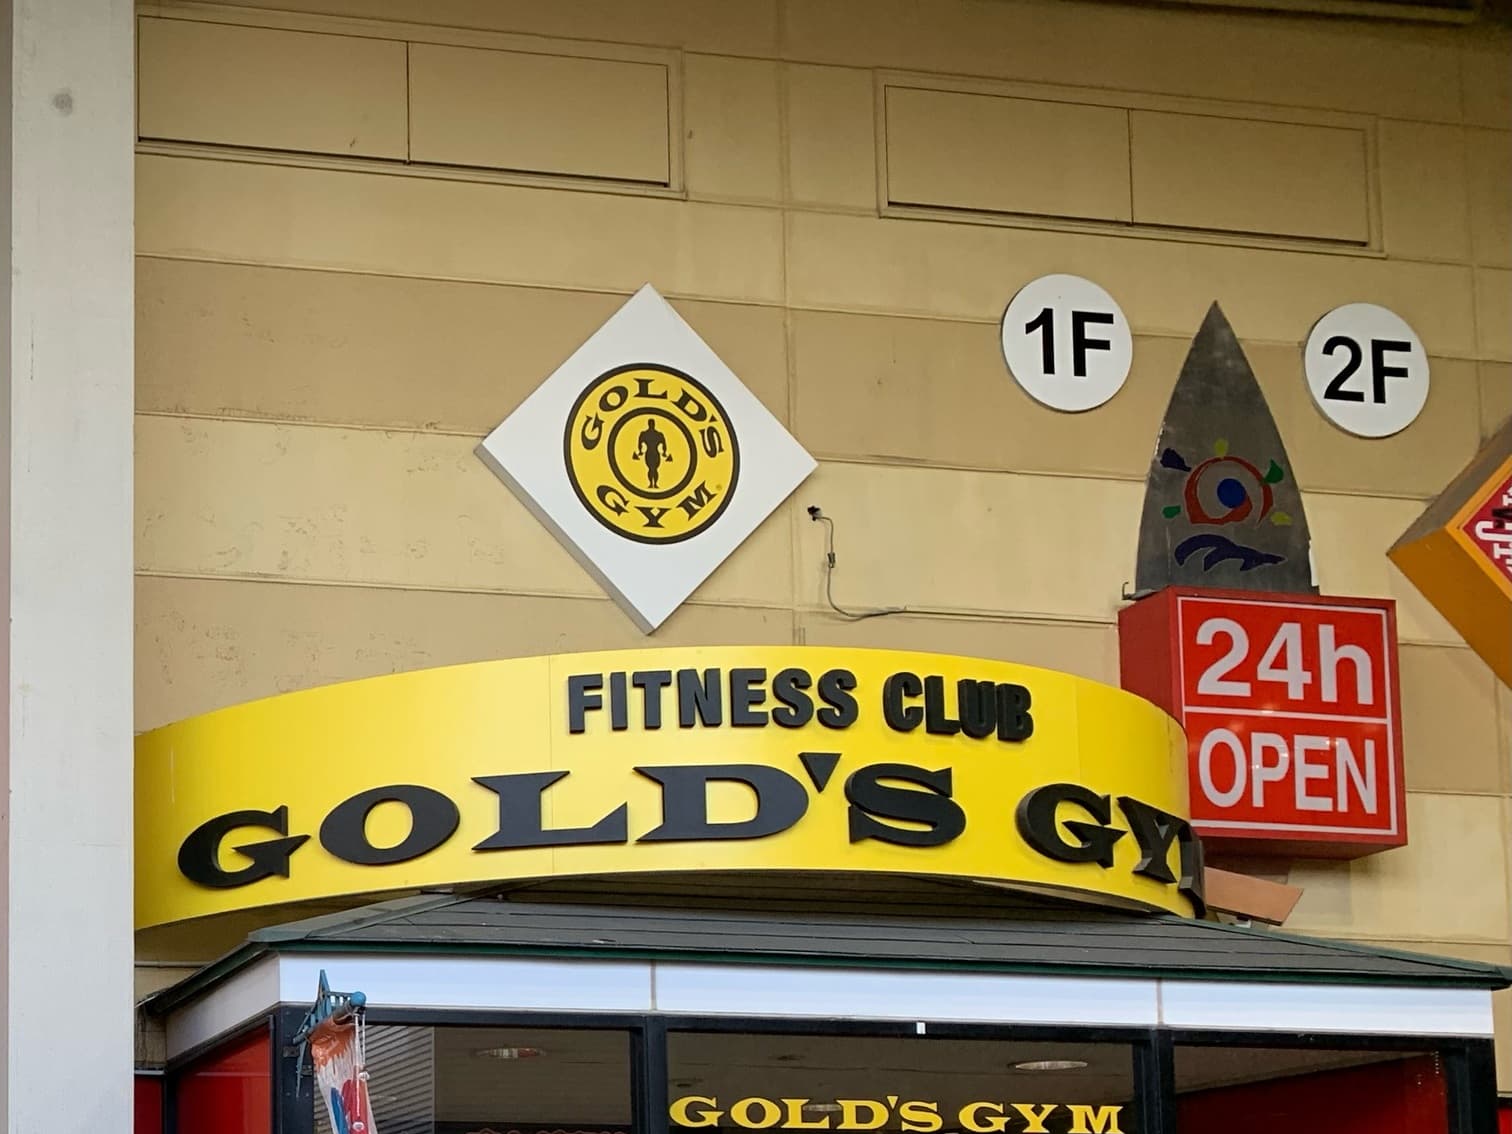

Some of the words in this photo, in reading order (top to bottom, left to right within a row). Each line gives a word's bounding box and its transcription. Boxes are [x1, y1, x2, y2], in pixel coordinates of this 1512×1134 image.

[1025, 307, 1115, 378] 1F
[1322, 336, 1412, 404] 2F
[580, 377, 724, 459] GOLD'S
[596, 479, 717, 528] GYM
[1195, 618, 1374, 706] 24h
[568, 668, 858, 734] FITNESS
[883, 672, 1034, 742] CLUB
[1198, 728, 1378, 815] OPEN
[177, 752, 967, 890] GOLD'S
[669, 1096, 944, 1133] GOLD'S
